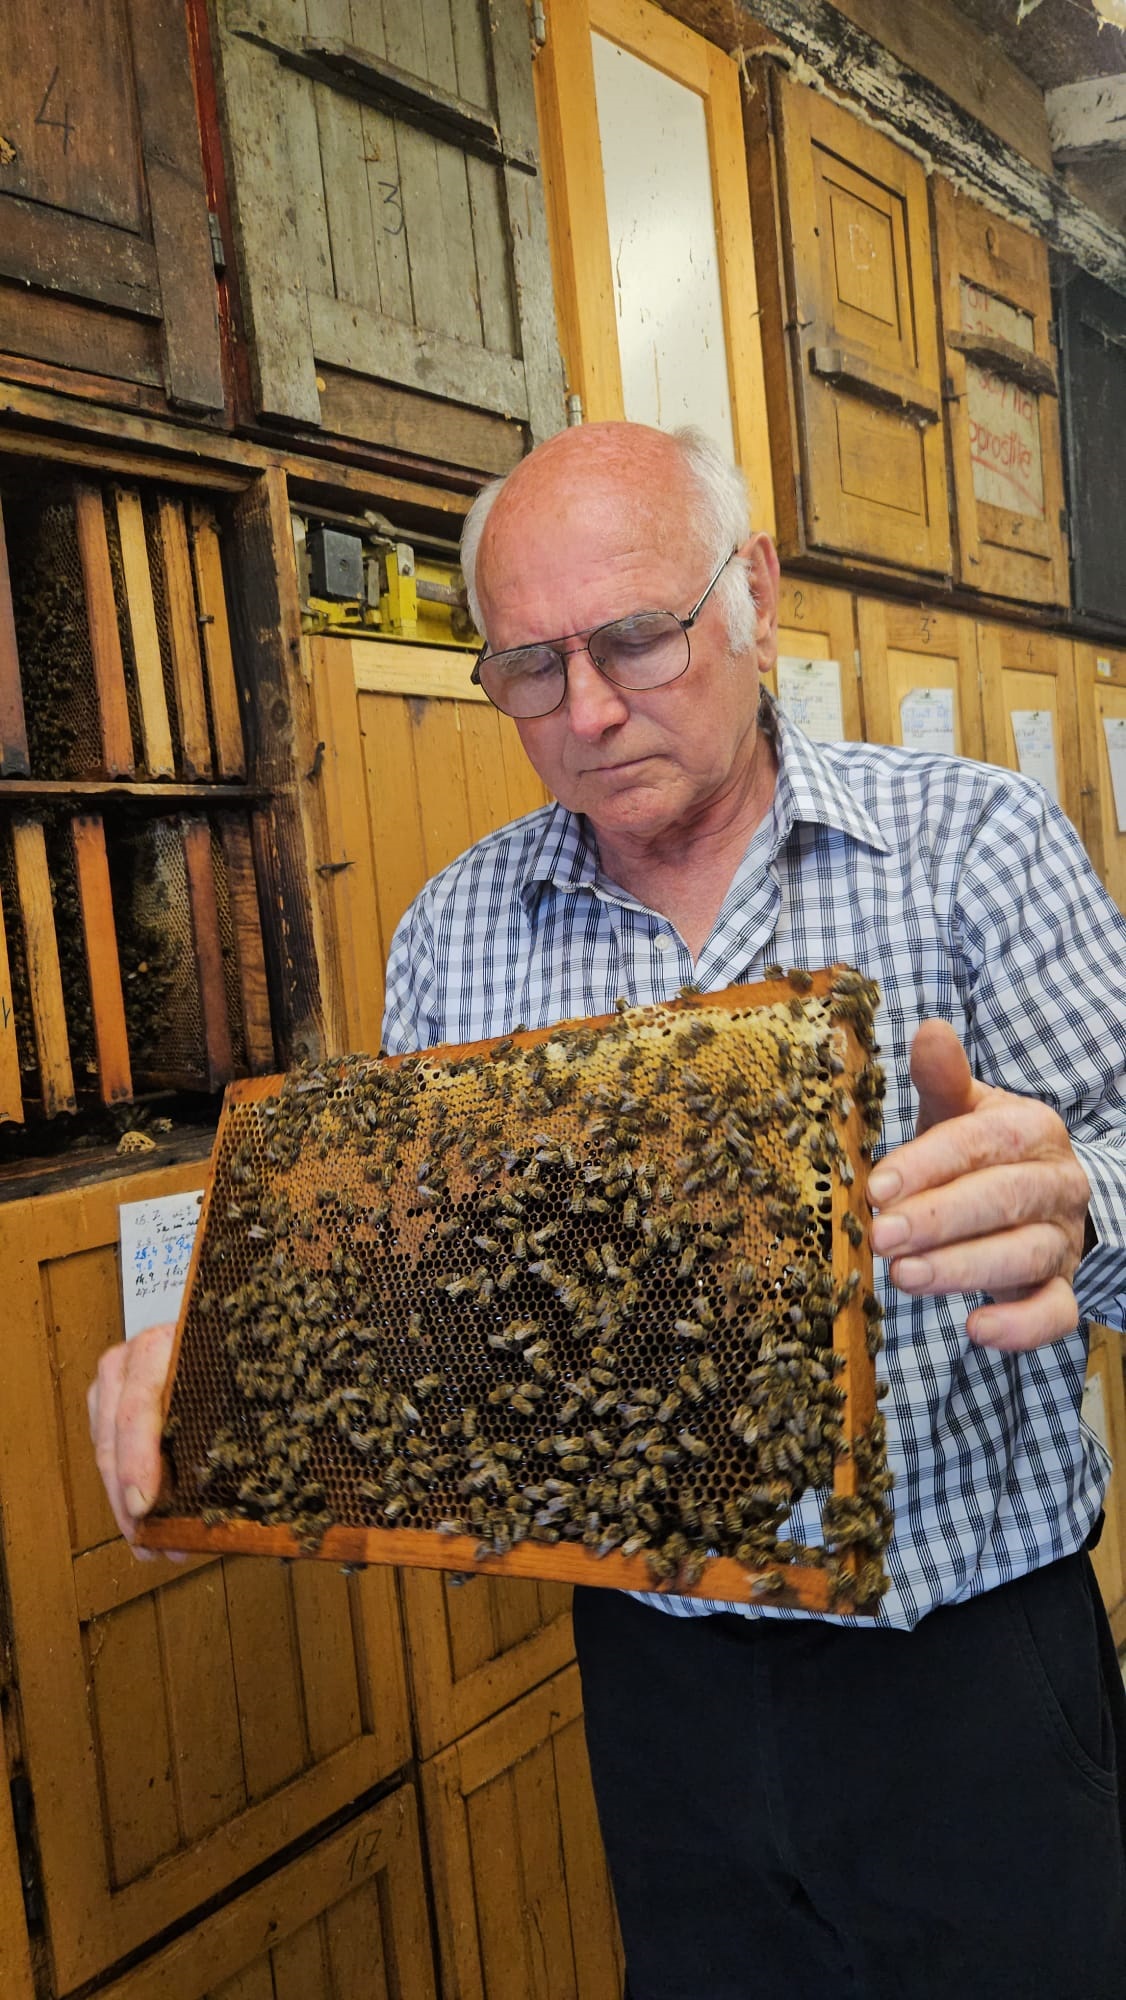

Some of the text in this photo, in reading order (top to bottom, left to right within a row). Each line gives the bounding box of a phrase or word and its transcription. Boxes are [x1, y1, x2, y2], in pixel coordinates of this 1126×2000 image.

[35, 65, 76, 156] 4
[377, 180, 404, 235] 3
[793, 590, 805, 620] 2
[920, 616, 931, 644] 3
[1026, 639, 1035, 664] 4
[345, 1827, 382, 1882] 17
